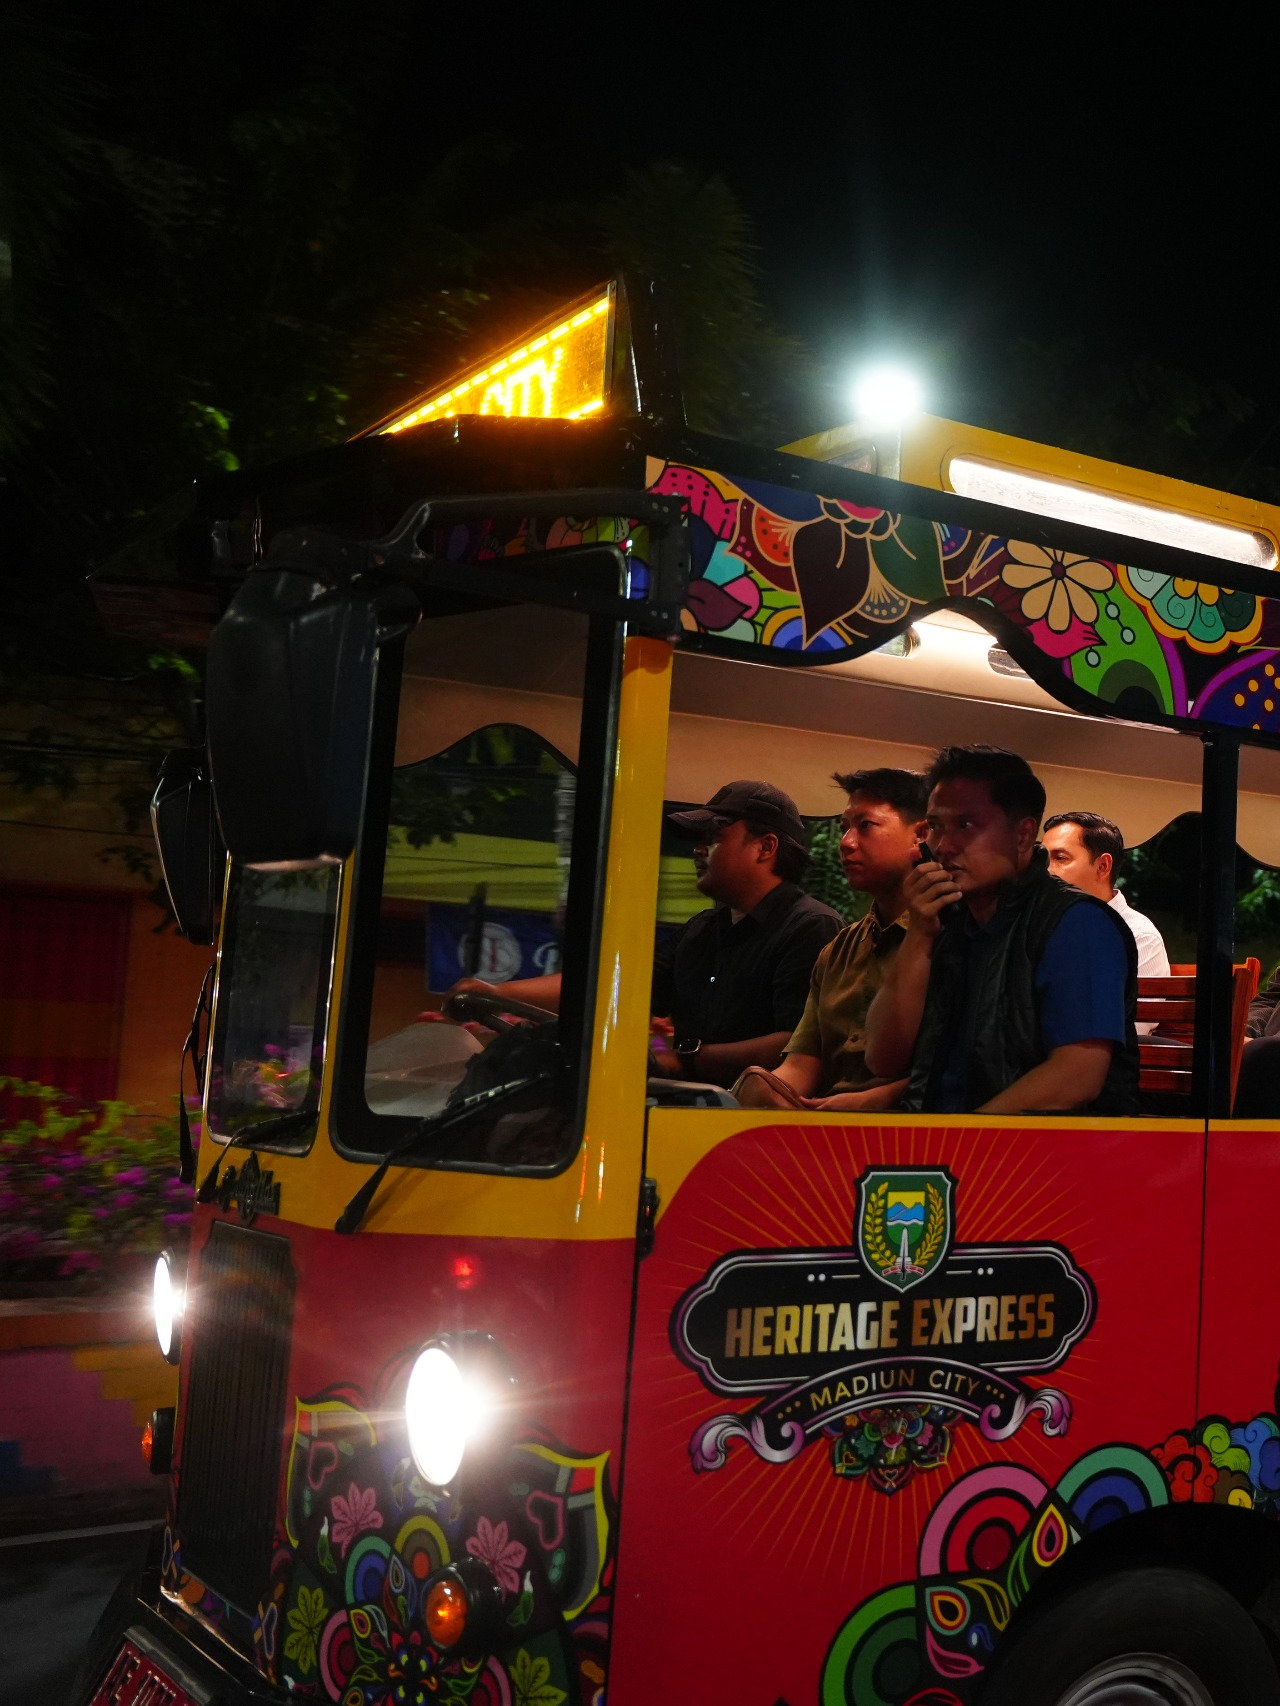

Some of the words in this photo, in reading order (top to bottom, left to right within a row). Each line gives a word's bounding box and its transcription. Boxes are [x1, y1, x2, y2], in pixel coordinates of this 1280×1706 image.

[724, 1300, 900, 1358] HERITAGE
[911, 1293, 1055, 1347] EXPRESS
[810, 1367, 916, 1412] MADIUN
[928, 1369, 981, 1397] CITY
